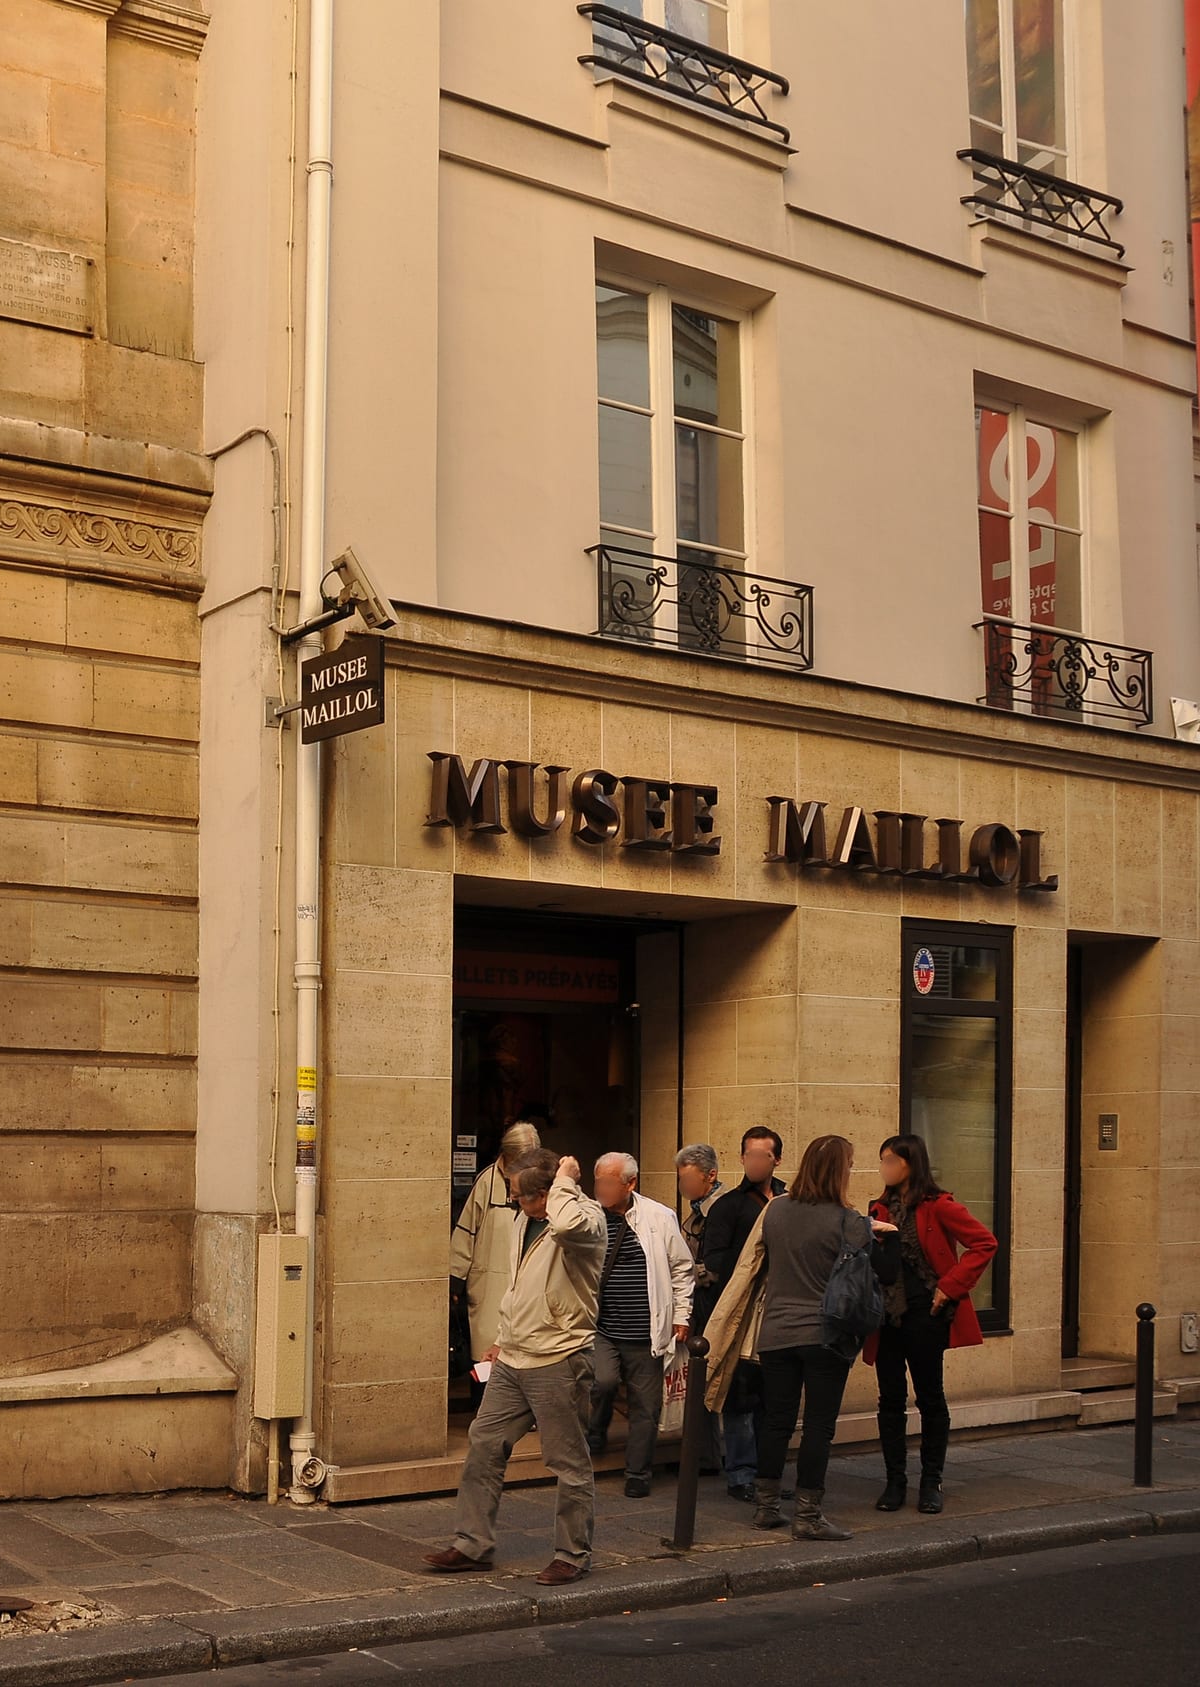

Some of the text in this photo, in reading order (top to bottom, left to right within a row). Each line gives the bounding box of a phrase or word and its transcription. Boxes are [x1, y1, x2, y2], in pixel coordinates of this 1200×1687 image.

[35, 252, 80, 273] MUSSET
[310, 656, 368, 693] MUSEE
[303, 688, 378, 728] MAILLOL
[424, 751, 1060, 892] MUSEE MAILLOL
[455, 966, 519, 986] ILLETS
